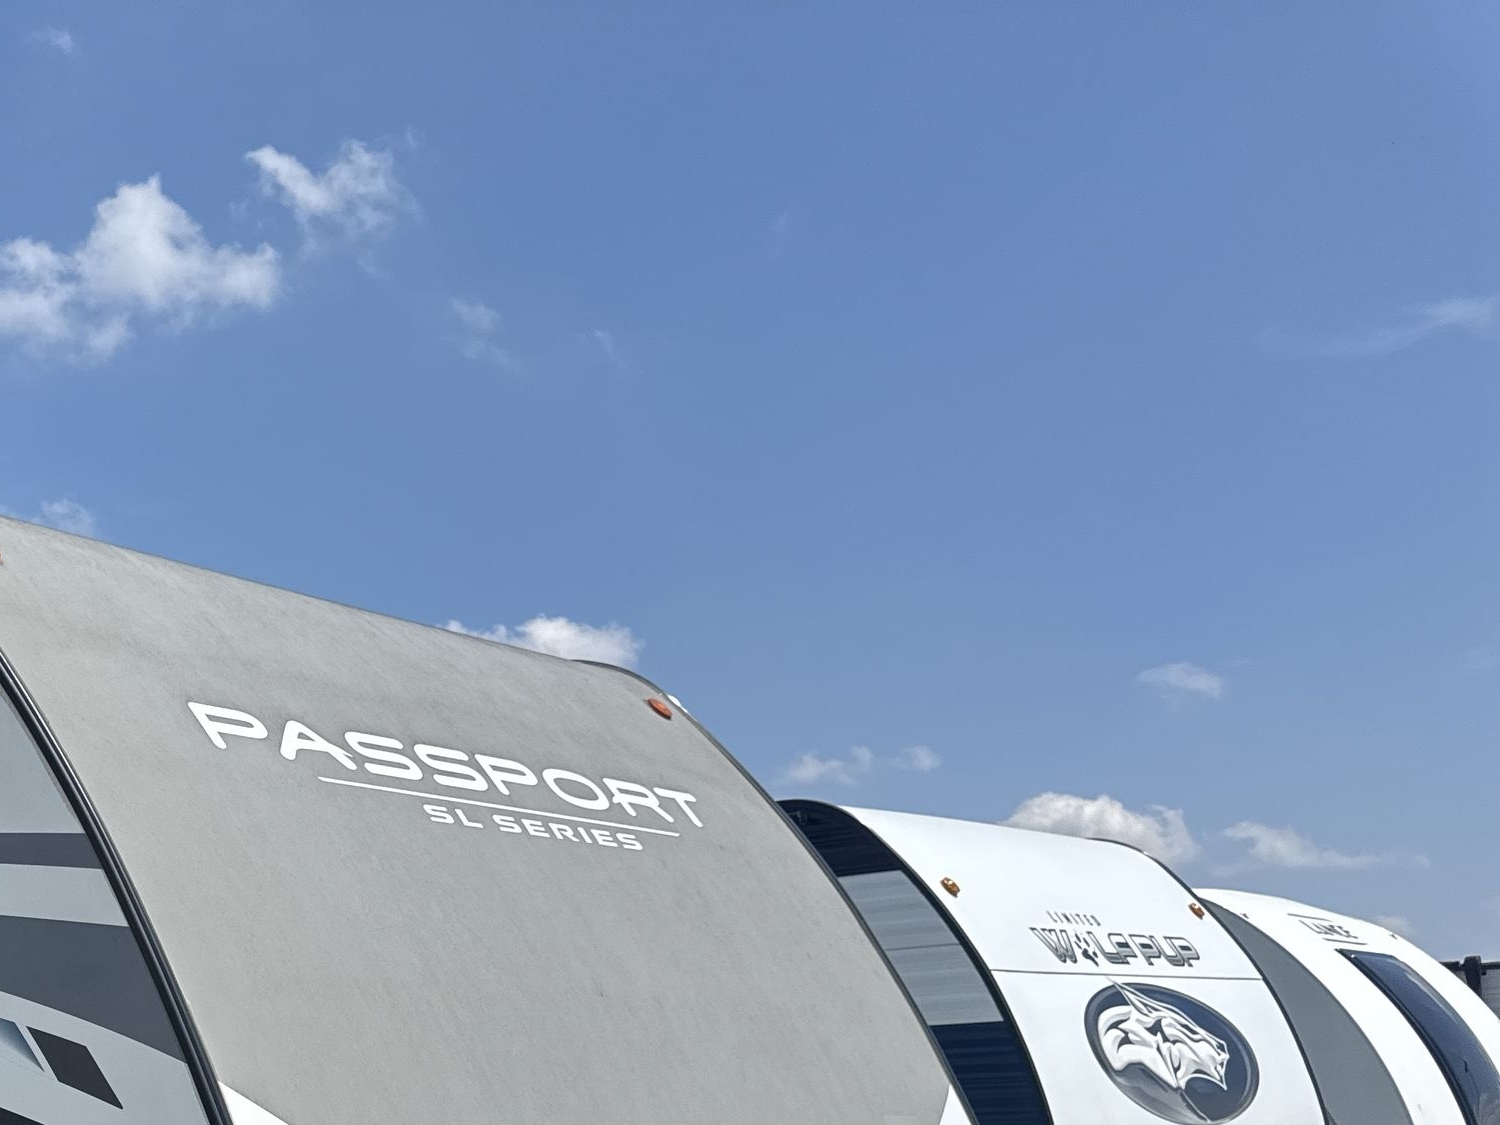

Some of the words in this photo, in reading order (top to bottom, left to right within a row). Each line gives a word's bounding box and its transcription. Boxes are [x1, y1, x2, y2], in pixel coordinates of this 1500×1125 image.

[187, 701, 704, 828] PASSPORT
[422, 804, 484, 829] SL
[492, 813, 644, 851] SERIES
[1046, 910, 1101, 927] LIMITED
